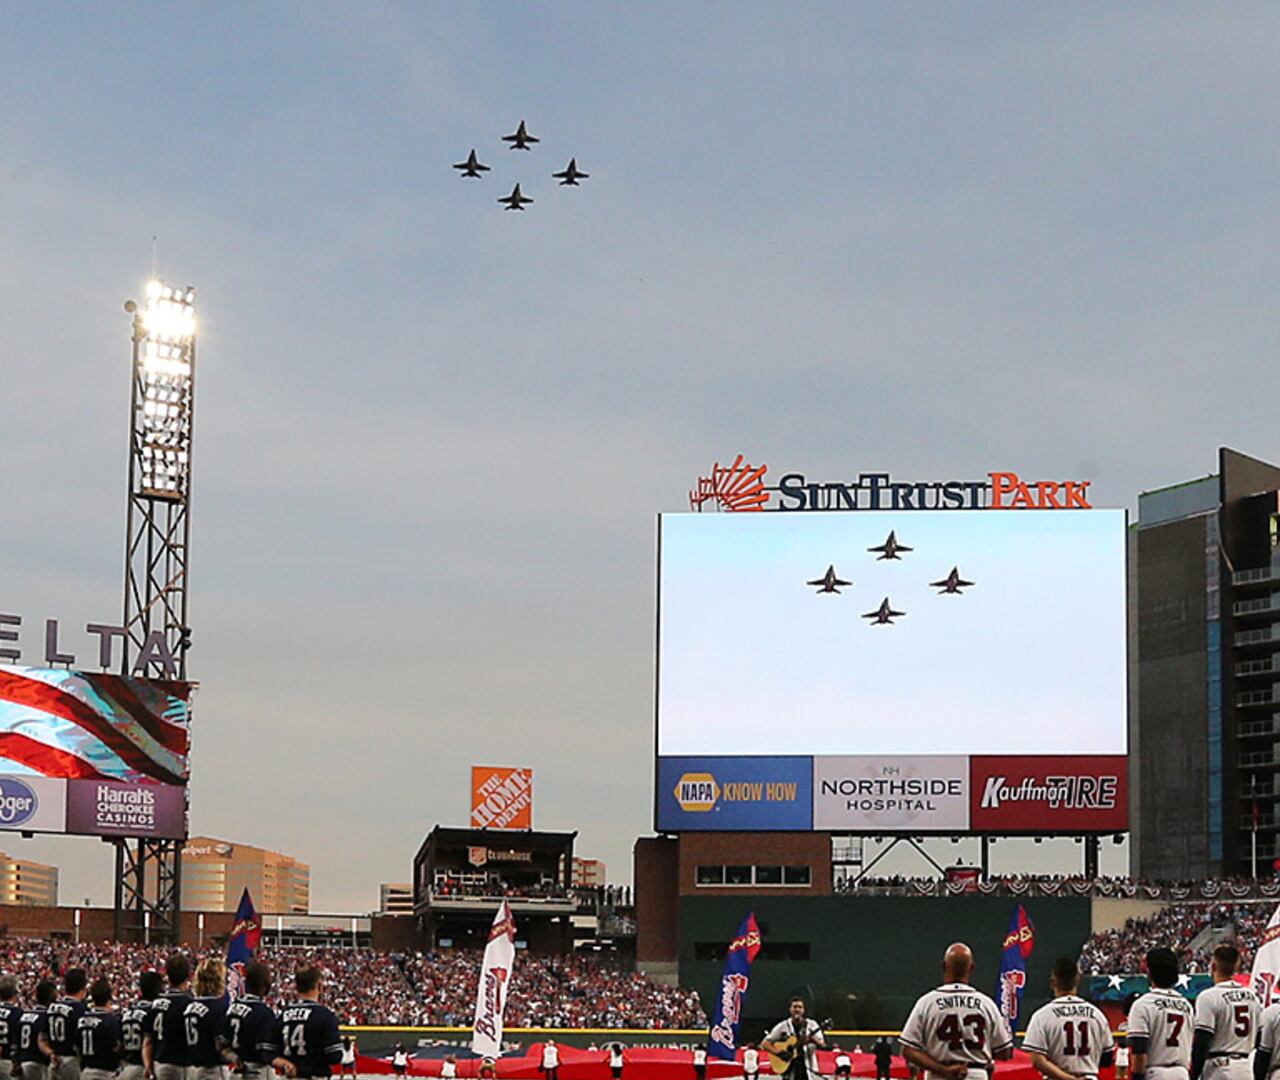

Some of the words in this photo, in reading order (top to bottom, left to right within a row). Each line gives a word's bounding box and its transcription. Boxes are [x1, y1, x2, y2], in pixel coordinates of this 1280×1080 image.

[987, 472, 1092, 509] PARK
[472, 769, 532, 828] HOME
[476, 773, 503, 797] THE
[681, 783, 714, 801] NAPA
[723, 783, 763, 801] KNOW
[766, 783, 797, 801] HOW
[821, 779, 962, 796] NORTHSIDE
[981, 777, 1069, 808] Kauffman
[1046, 776, 1118, 809] TIRE
[96, 812, 155, 825] CASINOS
[97, 802, 155, 815] CHEROKEE
[493, 790, 532, 828] DEPOT
[847, 800, 936, 811] HOSPITAL
[282, 1007, 313, 1022] GREEN
[936, 996, 982, 1011] SNITKER
[48, 1015, 66, 1042] 10
[937, 1013, 986, 1051] 43
[1166, 1013, 1185, 1047] 7
[1234, 1006, 1249, 1038] 5
[21, 1024, 31, 1049] 8
[81, 1028, 95, 1056] 11
[282, 1024, 307, 1056] 14
[1063, 1021, 1091, 1056] 11
